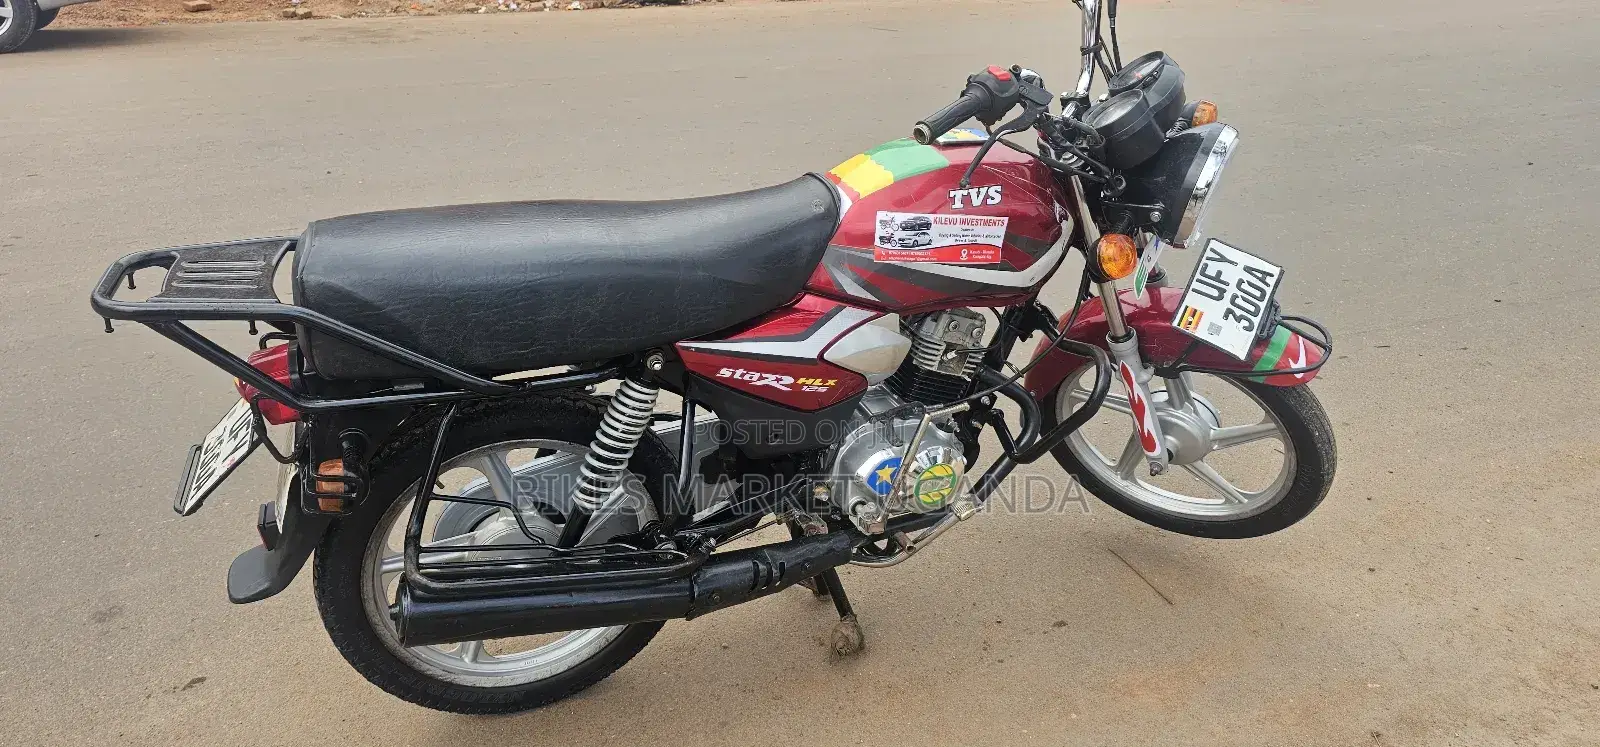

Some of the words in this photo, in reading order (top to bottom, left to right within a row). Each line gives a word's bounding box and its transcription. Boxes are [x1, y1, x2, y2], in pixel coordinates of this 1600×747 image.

[949, 185, 1002, 210] TVS
[933, 216, 958, 226] KILEVU
[959, 217, 1005, 227] INVESTMENTS
[1191, 247, 1238, 301] UFY
[1222, 264, 1275, 333] 300A
[796, 377, 838, 386] HLX
[801, 385, 829, 393] 125
